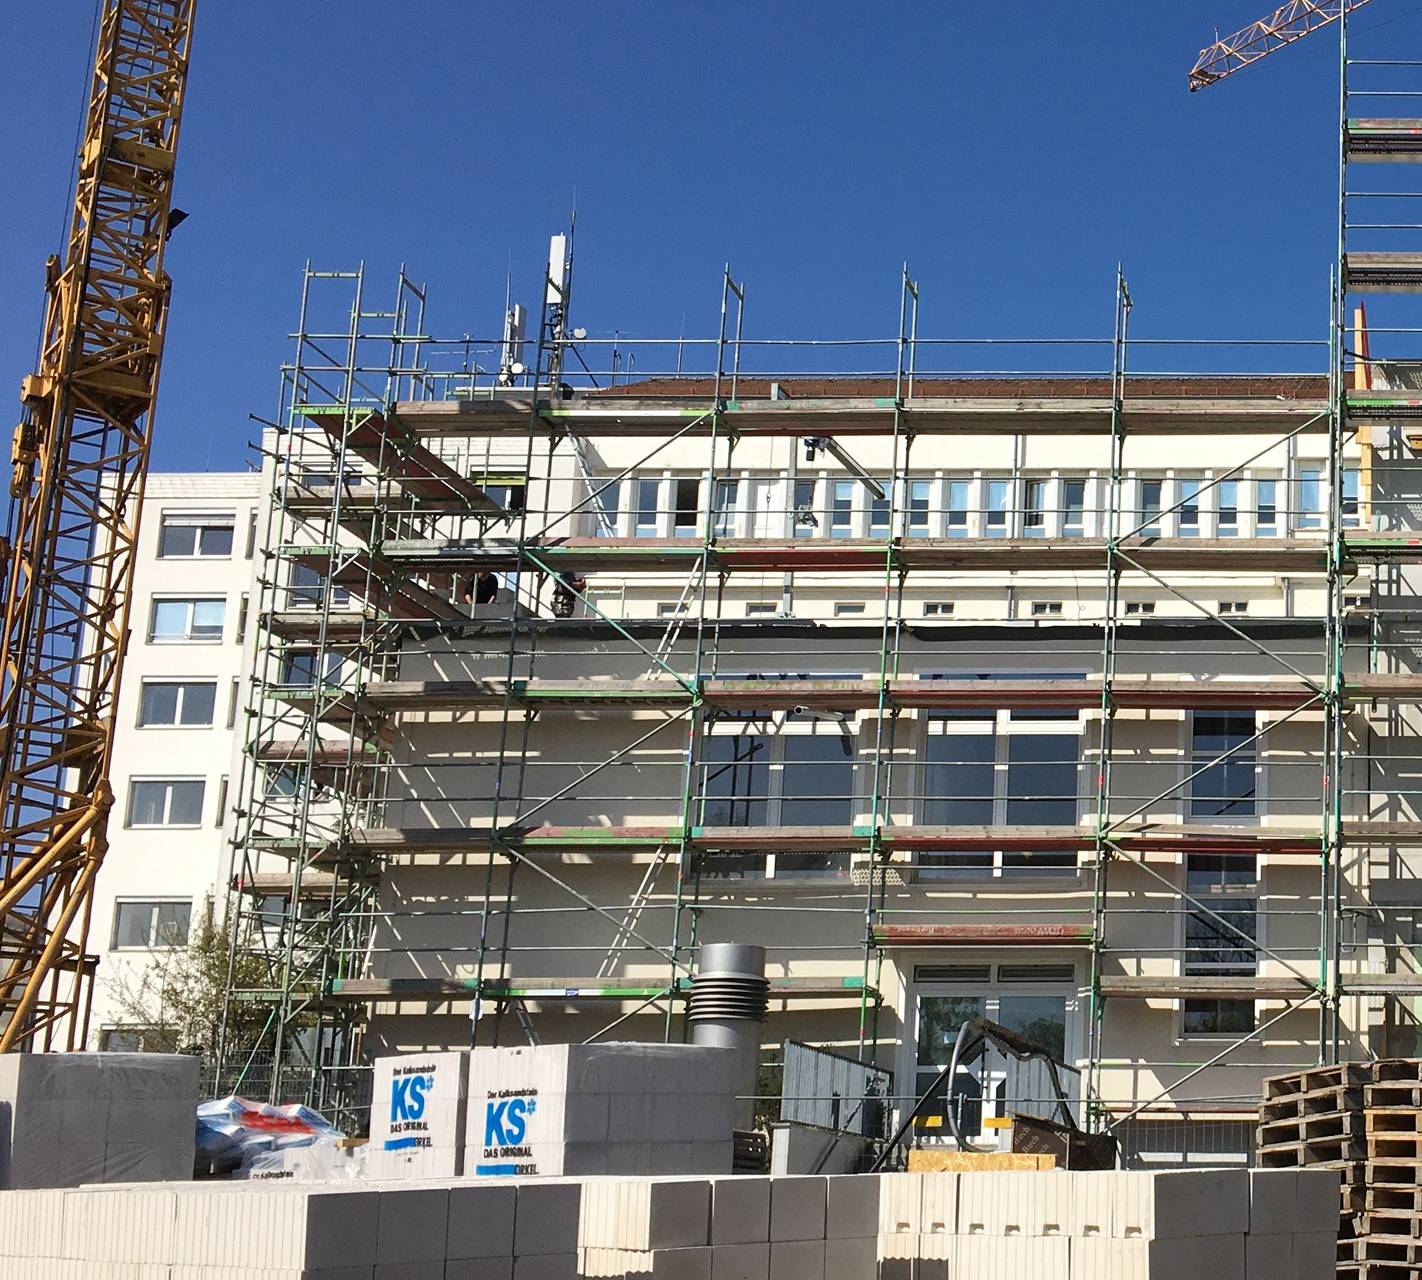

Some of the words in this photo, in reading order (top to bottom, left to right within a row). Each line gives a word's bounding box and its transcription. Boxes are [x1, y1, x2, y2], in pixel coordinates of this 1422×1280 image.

[391, 1075, 426, 1122] KS
[390, 1123, 402, 1134] DAS
[484, 1098, 527, 1147] KS
[483, 1148, 498, 1159] DAS
[500, 1146, 533, 1158] ORIGINAL
